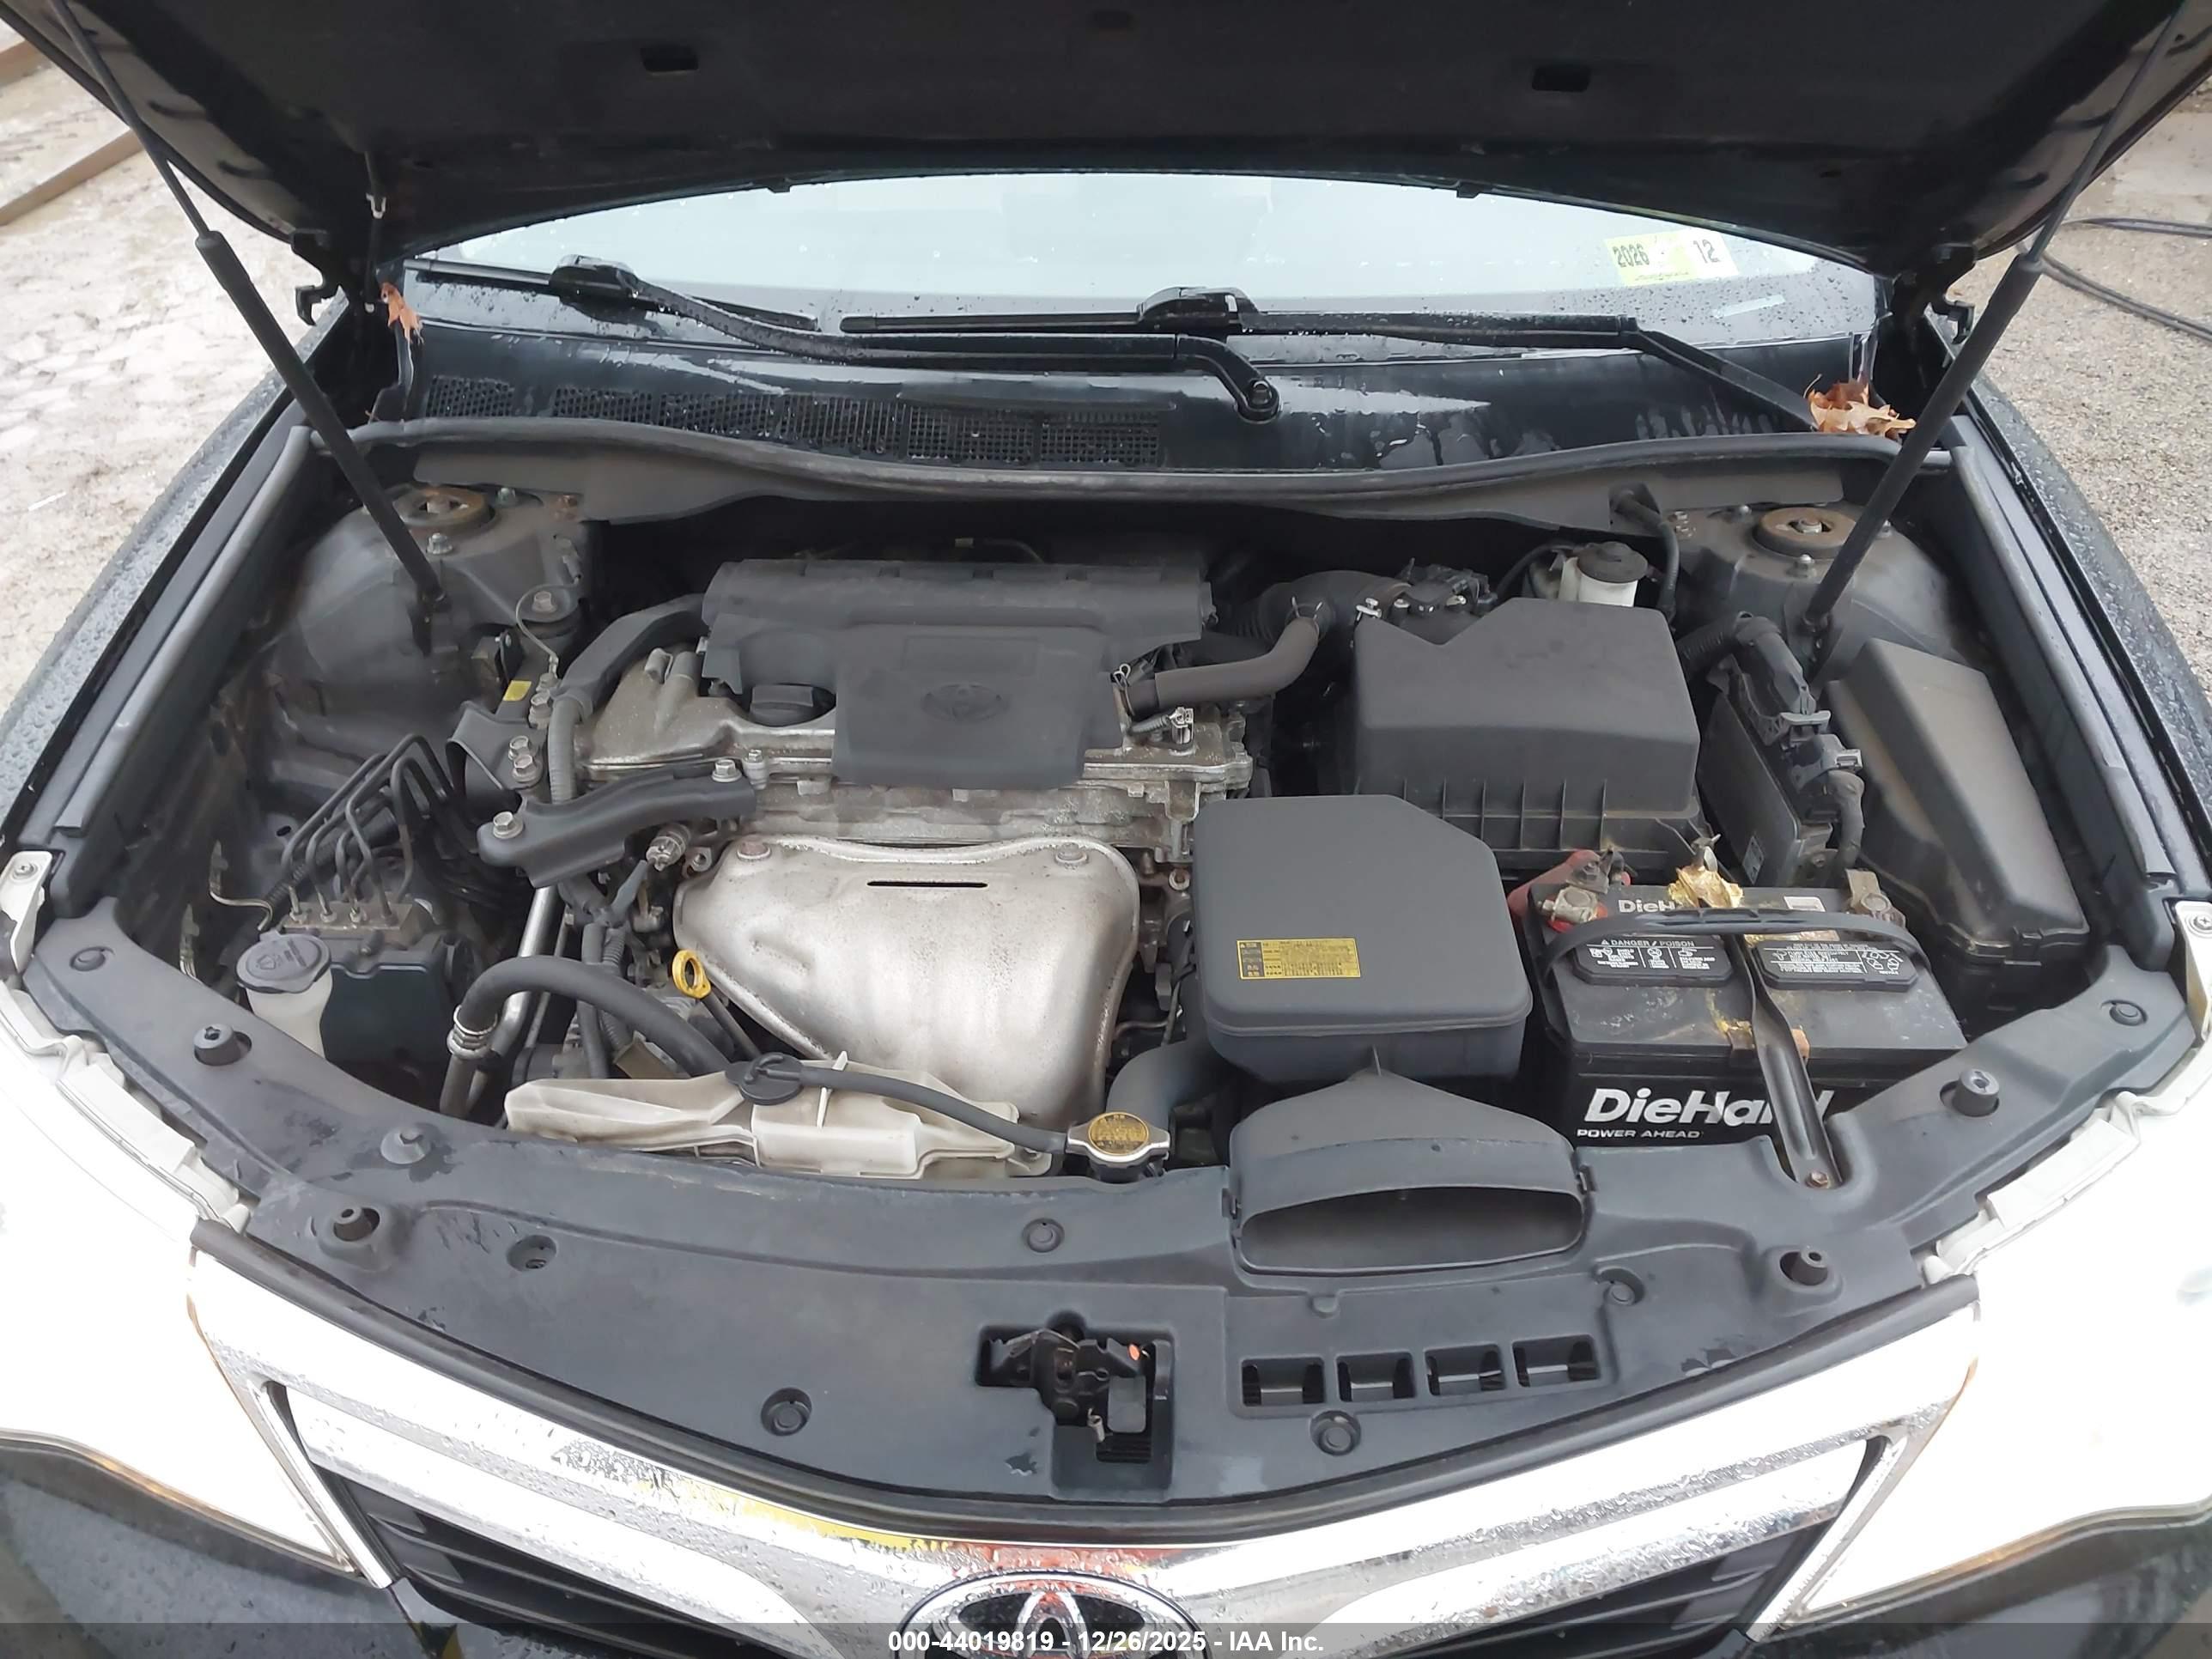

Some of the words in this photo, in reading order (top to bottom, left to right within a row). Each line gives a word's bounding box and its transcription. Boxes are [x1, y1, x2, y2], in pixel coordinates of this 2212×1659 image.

[1613, 244, 1650, 267] 2026
[1693, 240, 1721, 264] 12
[1619, 899, 1676, 913] DieH
[1584, 1087, 1835, 1127] DieHa
[1577, 1129, 1637, 1138] POWER
[1640, 1130, 1701, 1139] AHEAD
